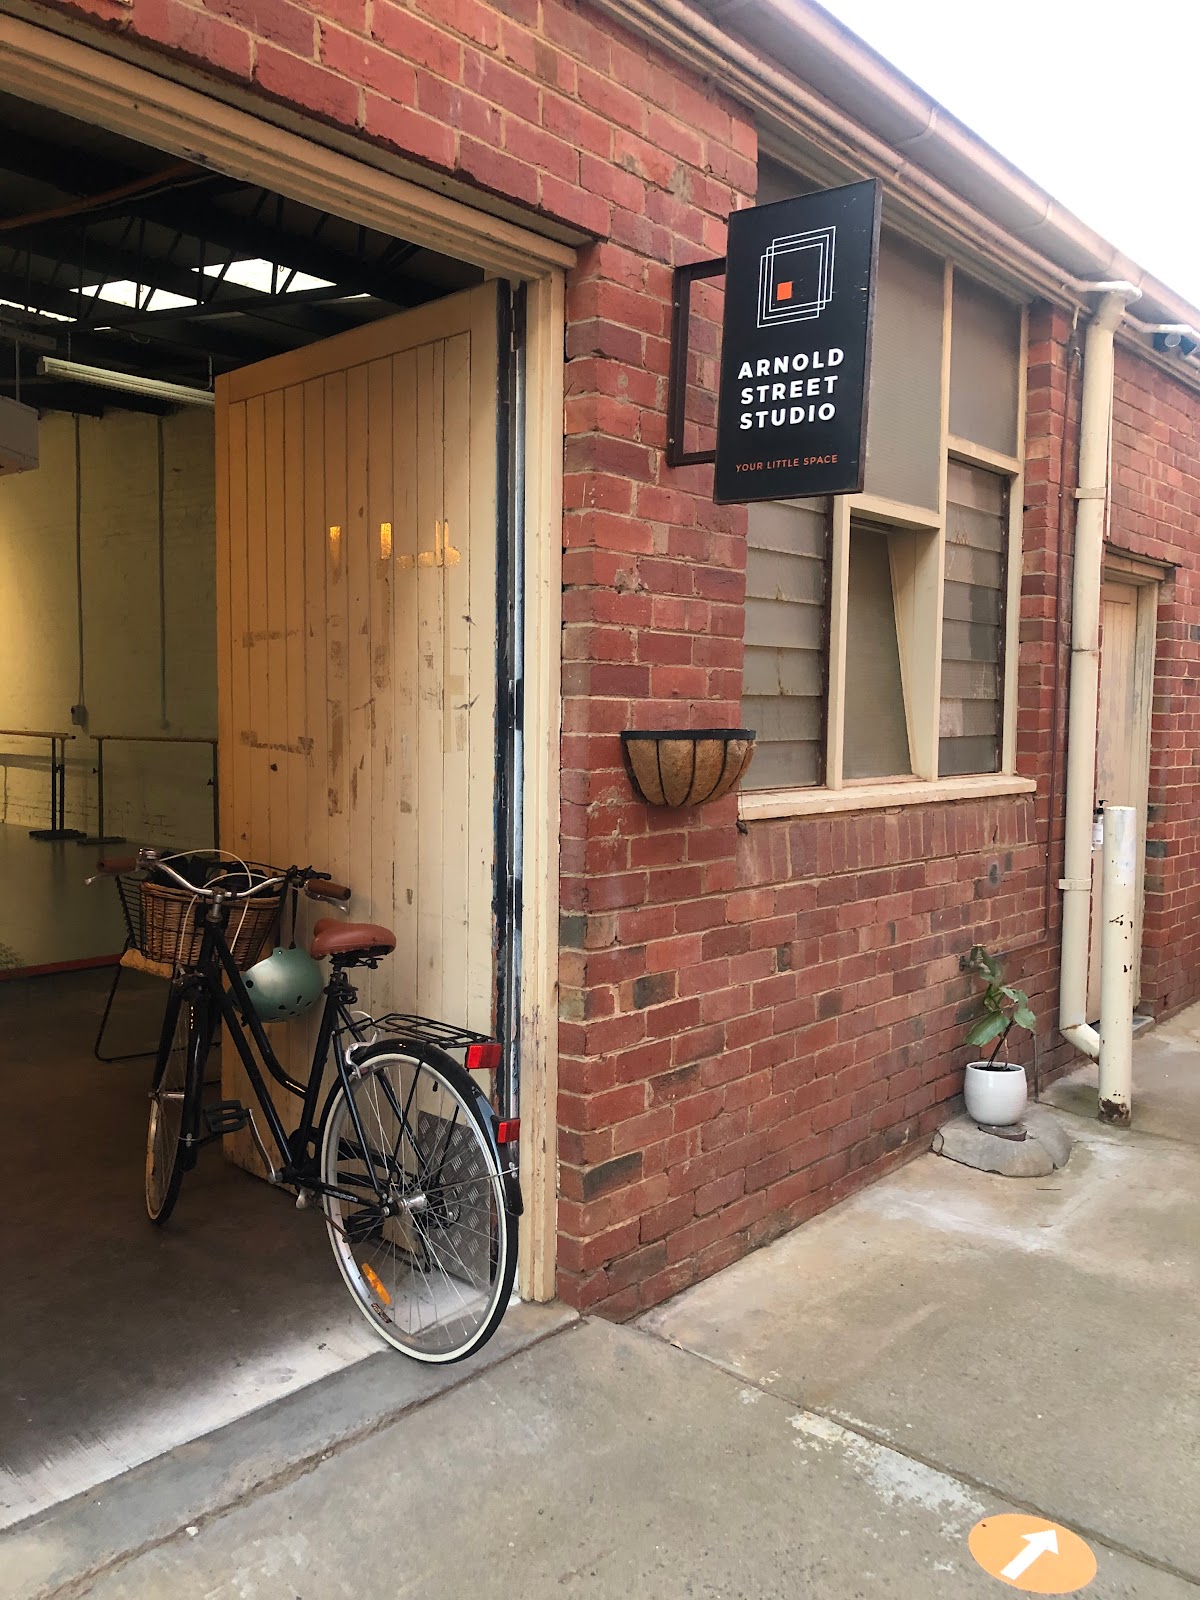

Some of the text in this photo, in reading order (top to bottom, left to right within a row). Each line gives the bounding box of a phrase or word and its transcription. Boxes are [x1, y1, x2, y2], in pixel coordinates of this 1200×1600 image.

[737, 348, 844, 380] ARNOLD
[740, 375, 838, 405] STREET
[739, 402, 836, 430] STUDIO
[735, 454, 838, 473] YOUR LITTLE SPACE
